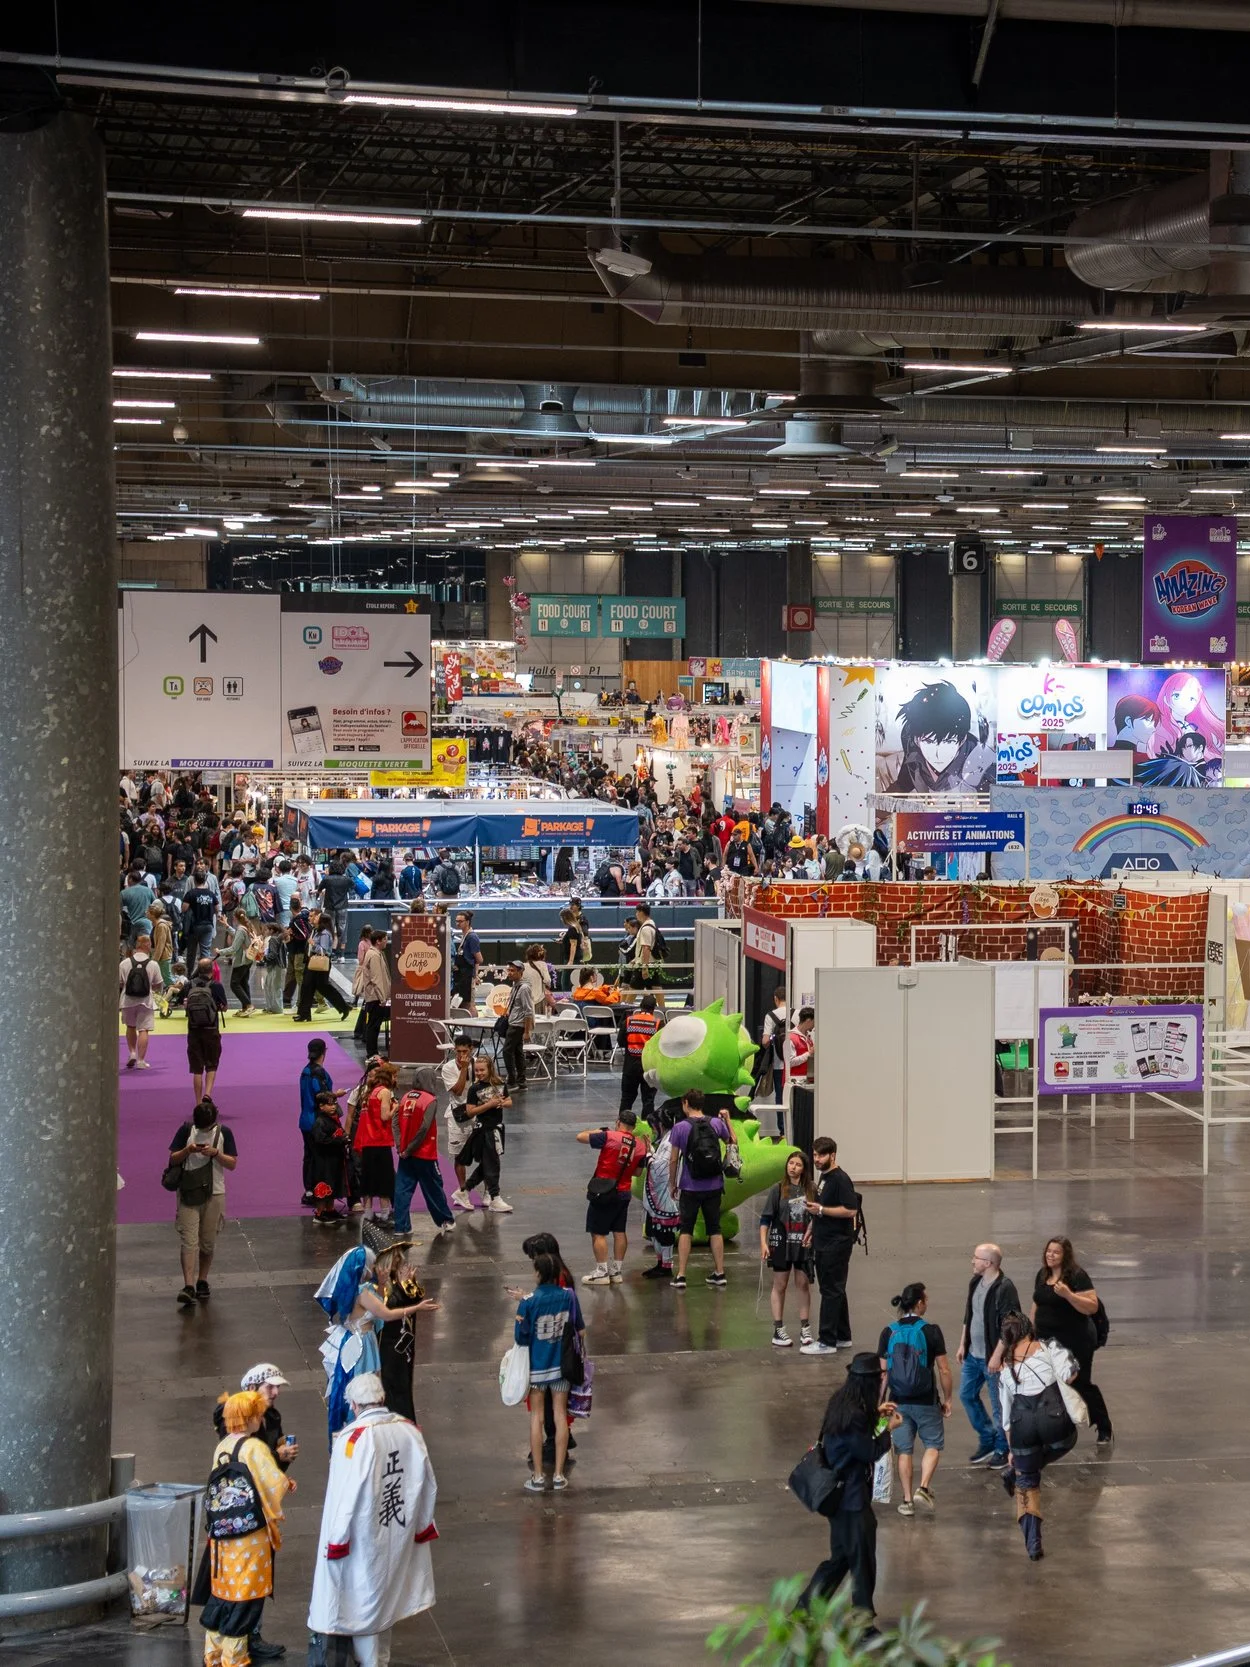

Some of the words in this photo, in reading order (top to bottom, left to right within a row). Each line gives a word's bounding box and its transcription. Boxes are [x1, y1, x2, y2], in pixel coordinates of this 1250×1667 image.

[962, 551, 978, 570] 6
[1153, 567, 1227, 604] AMAZING
[818, 600, 843, 609] SORTIE
[845, 600, 855, 609] DE
[859, 601, 891, 609] SECOURS
[1002, 604, 1027, 612] SORTIE
[1031, 604, 1040, 612] DE
[1044, 604, 1078, 612] SECOURS
[1171, 603, 1198, 614] KOREAN
[1198, 596, 1217, 611] WAVE
[538, 604, 560, 618] FOOD
[563, 604, 591, 618] COURT
[610, 605, 638, 619] FOOD
[641, 605, 677, 619] COURT
[334, 626, 369, 639] IDOL
[528, 666, 549, 675] Hall
[550, 666, 556, 675] 6
[589, 666, 601, 675] P1
[1043, 673, 1065, 694] K-
[332, 708, 358, 716] Besoin
[360, 708, 386, 716] d'infos
[1042, 719, 1065, 727] 2025
[998, 763, 1017, 771] 2025
[1133, 804, 1158, 814] 10:46
[375, 823, 420, 832] PARKAGE
[541, 822, 584, 831] PARKAGE
[907, 829, 949, 840] ACTIVITÉS
[952, 831, 962, 840] ET
[965, 830, 1015, 840] ANIMATIONS
[379, 1450, 405, 1528] 正義
